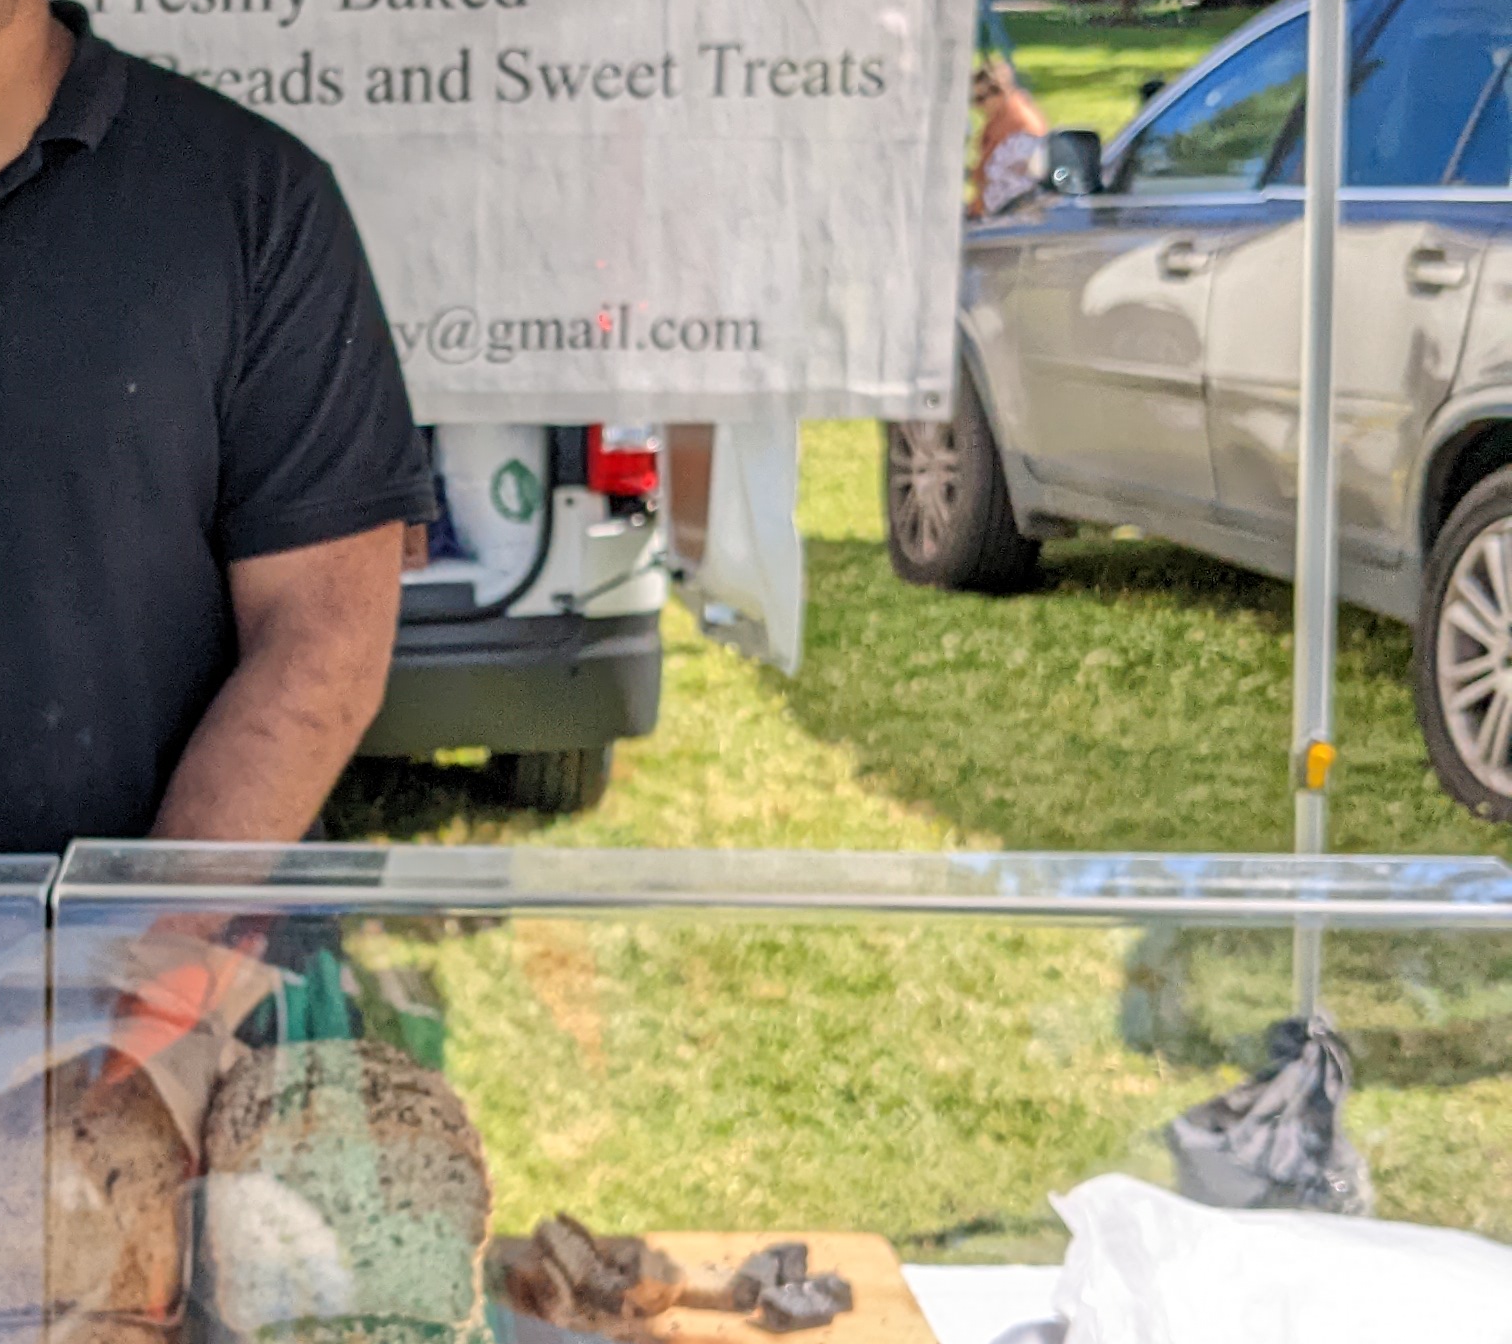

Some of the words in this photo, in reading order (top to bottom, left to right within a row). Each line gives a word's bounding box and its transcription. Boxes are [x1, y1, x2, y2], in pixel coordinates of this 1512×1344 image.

[366, 49, 471, 104] and
[495, 49, 678, 104] Sweet
[699, 41, 885, 100] Treats
[390, 304, 761, 364] y@gmail.com
